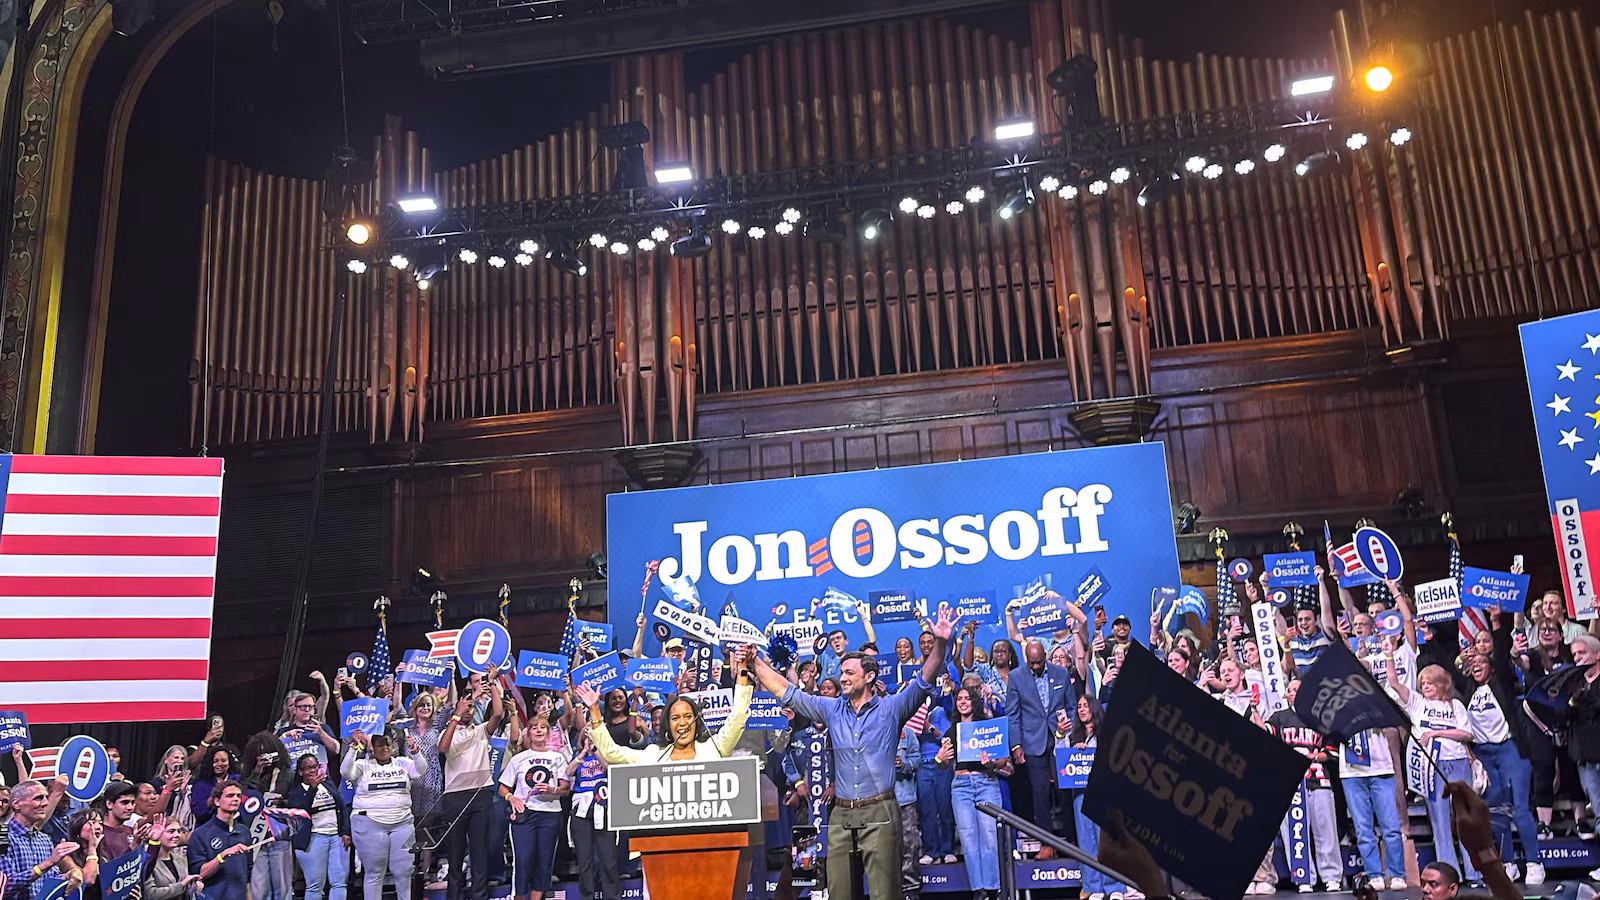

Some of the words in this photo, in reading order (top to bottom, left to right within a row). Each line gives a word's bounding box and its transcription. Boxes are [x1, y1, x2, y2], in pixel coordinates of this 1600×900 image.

[659, 521, 813, 585] Jon
[829, 484, 1112, 578] Ossoff
[1276, 558, 1304, 566] Atlanta
[1272, 564, 1310, 577] Ossoff
[1479, 576, 1515, 587] Atlanta
[880, 594, 907, 602] Atlanta
[1471, 584, 1520, 600] Ossoff
[959, 596, 986, 605] Atlanta
[1434, 600, 1458, 608] BOTTOMS
[876, 601, 911, 614] Ossoff
[956, 603, 991, 616] Ossoff
[1030, 603, 1057, 614] Atlanta
[1027, 609, 1063, 626] Ossoff
[1424, 611, 1456, 622] GOVERNOR
[531, 658, 559, 667] Atlanta
[407, 663, 446, 677] Ossoff
[525, 666, 563, 679] Ossoff
[583, 663, 611, 678] Atlanta
[582, 668, 618, 688] Ossoff
[633, 671, 673, 683] Ossoff
[346, 713, 380, 727] Ossoff
[0, 727, 27, 740] ssoff
[973, 726, 999, 736] Atlanta
[1137, 693, 1247, 780] Atlanta
[969, 733, 1003, 749] Ossoff
[290, 745, 320, 759] ssoff
[1069, 753, 1095, 762] Atlant
[1163, 742, 1188, 765] for
[1066, 763, 1092, 776] Oss
[1411, 746, 1422, 792] KEISH
[629, 772, 740, 805] UNITED
[1108, 724, 1254, 842] Ossoff
[650, 800, 733, 822] GEORGIA
[116, 854, 142, 875] Atlan
[1348, 854, 1364, 867] Jo
[1032, 868, 1056, 881] Jon
[1057, 867, 1081, 881] Oss
